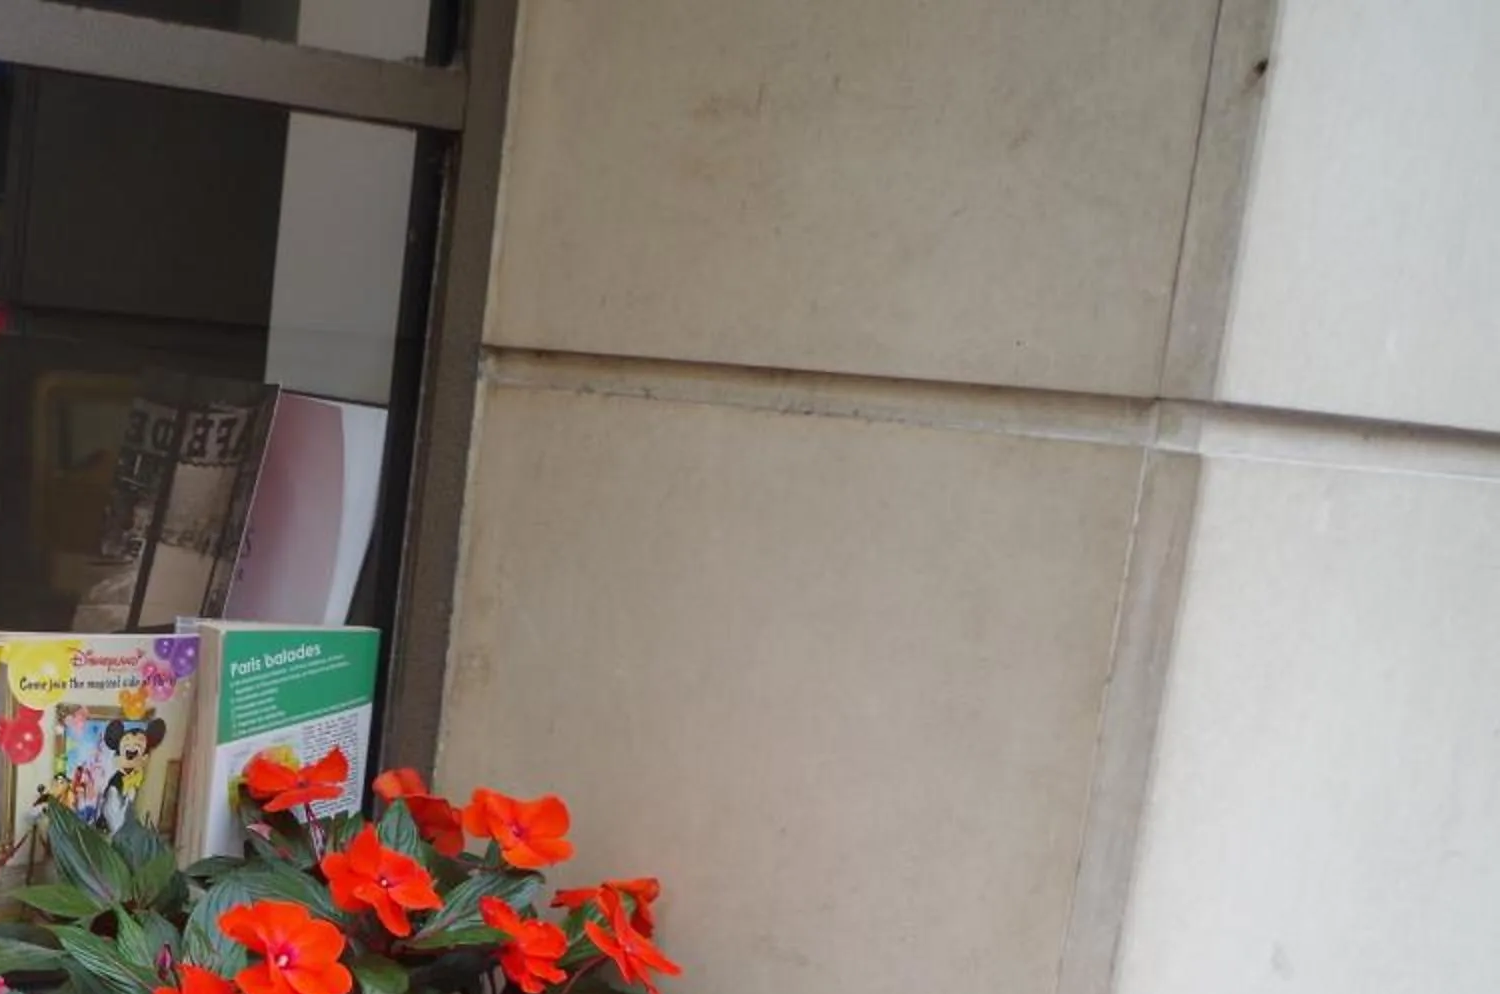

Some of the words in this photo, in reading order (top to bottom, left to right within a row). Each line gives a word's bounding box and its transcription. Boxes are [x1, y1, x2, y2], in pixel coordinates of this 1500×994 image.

[229, 656, 261, 678] Paris
[263, 643, 322, 668] balades
[69, 676, 85, 689] the
